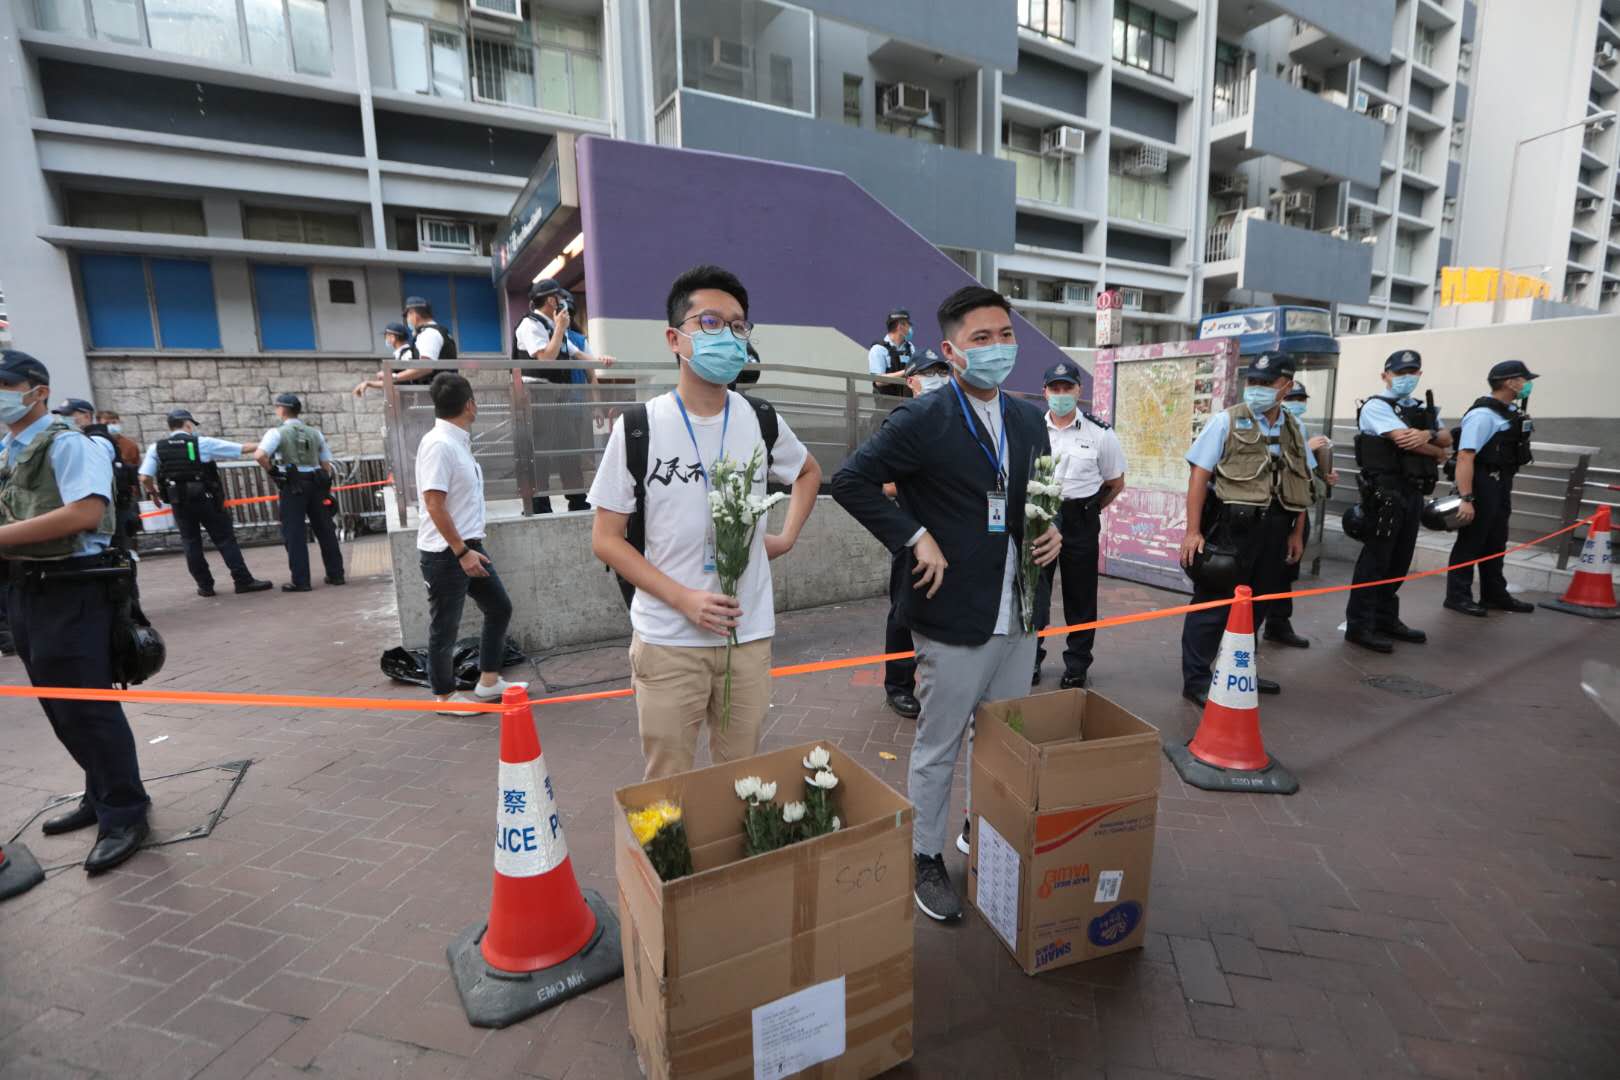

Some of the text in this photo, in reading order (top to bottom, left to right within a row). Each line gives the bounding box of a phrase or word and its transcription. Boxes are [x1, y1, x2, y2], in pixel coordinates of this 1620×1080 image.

[1232, 650, 1256, 669] 警
[1227, 674, 1257, 693] POL
[497, 788, 527, 815] 察
